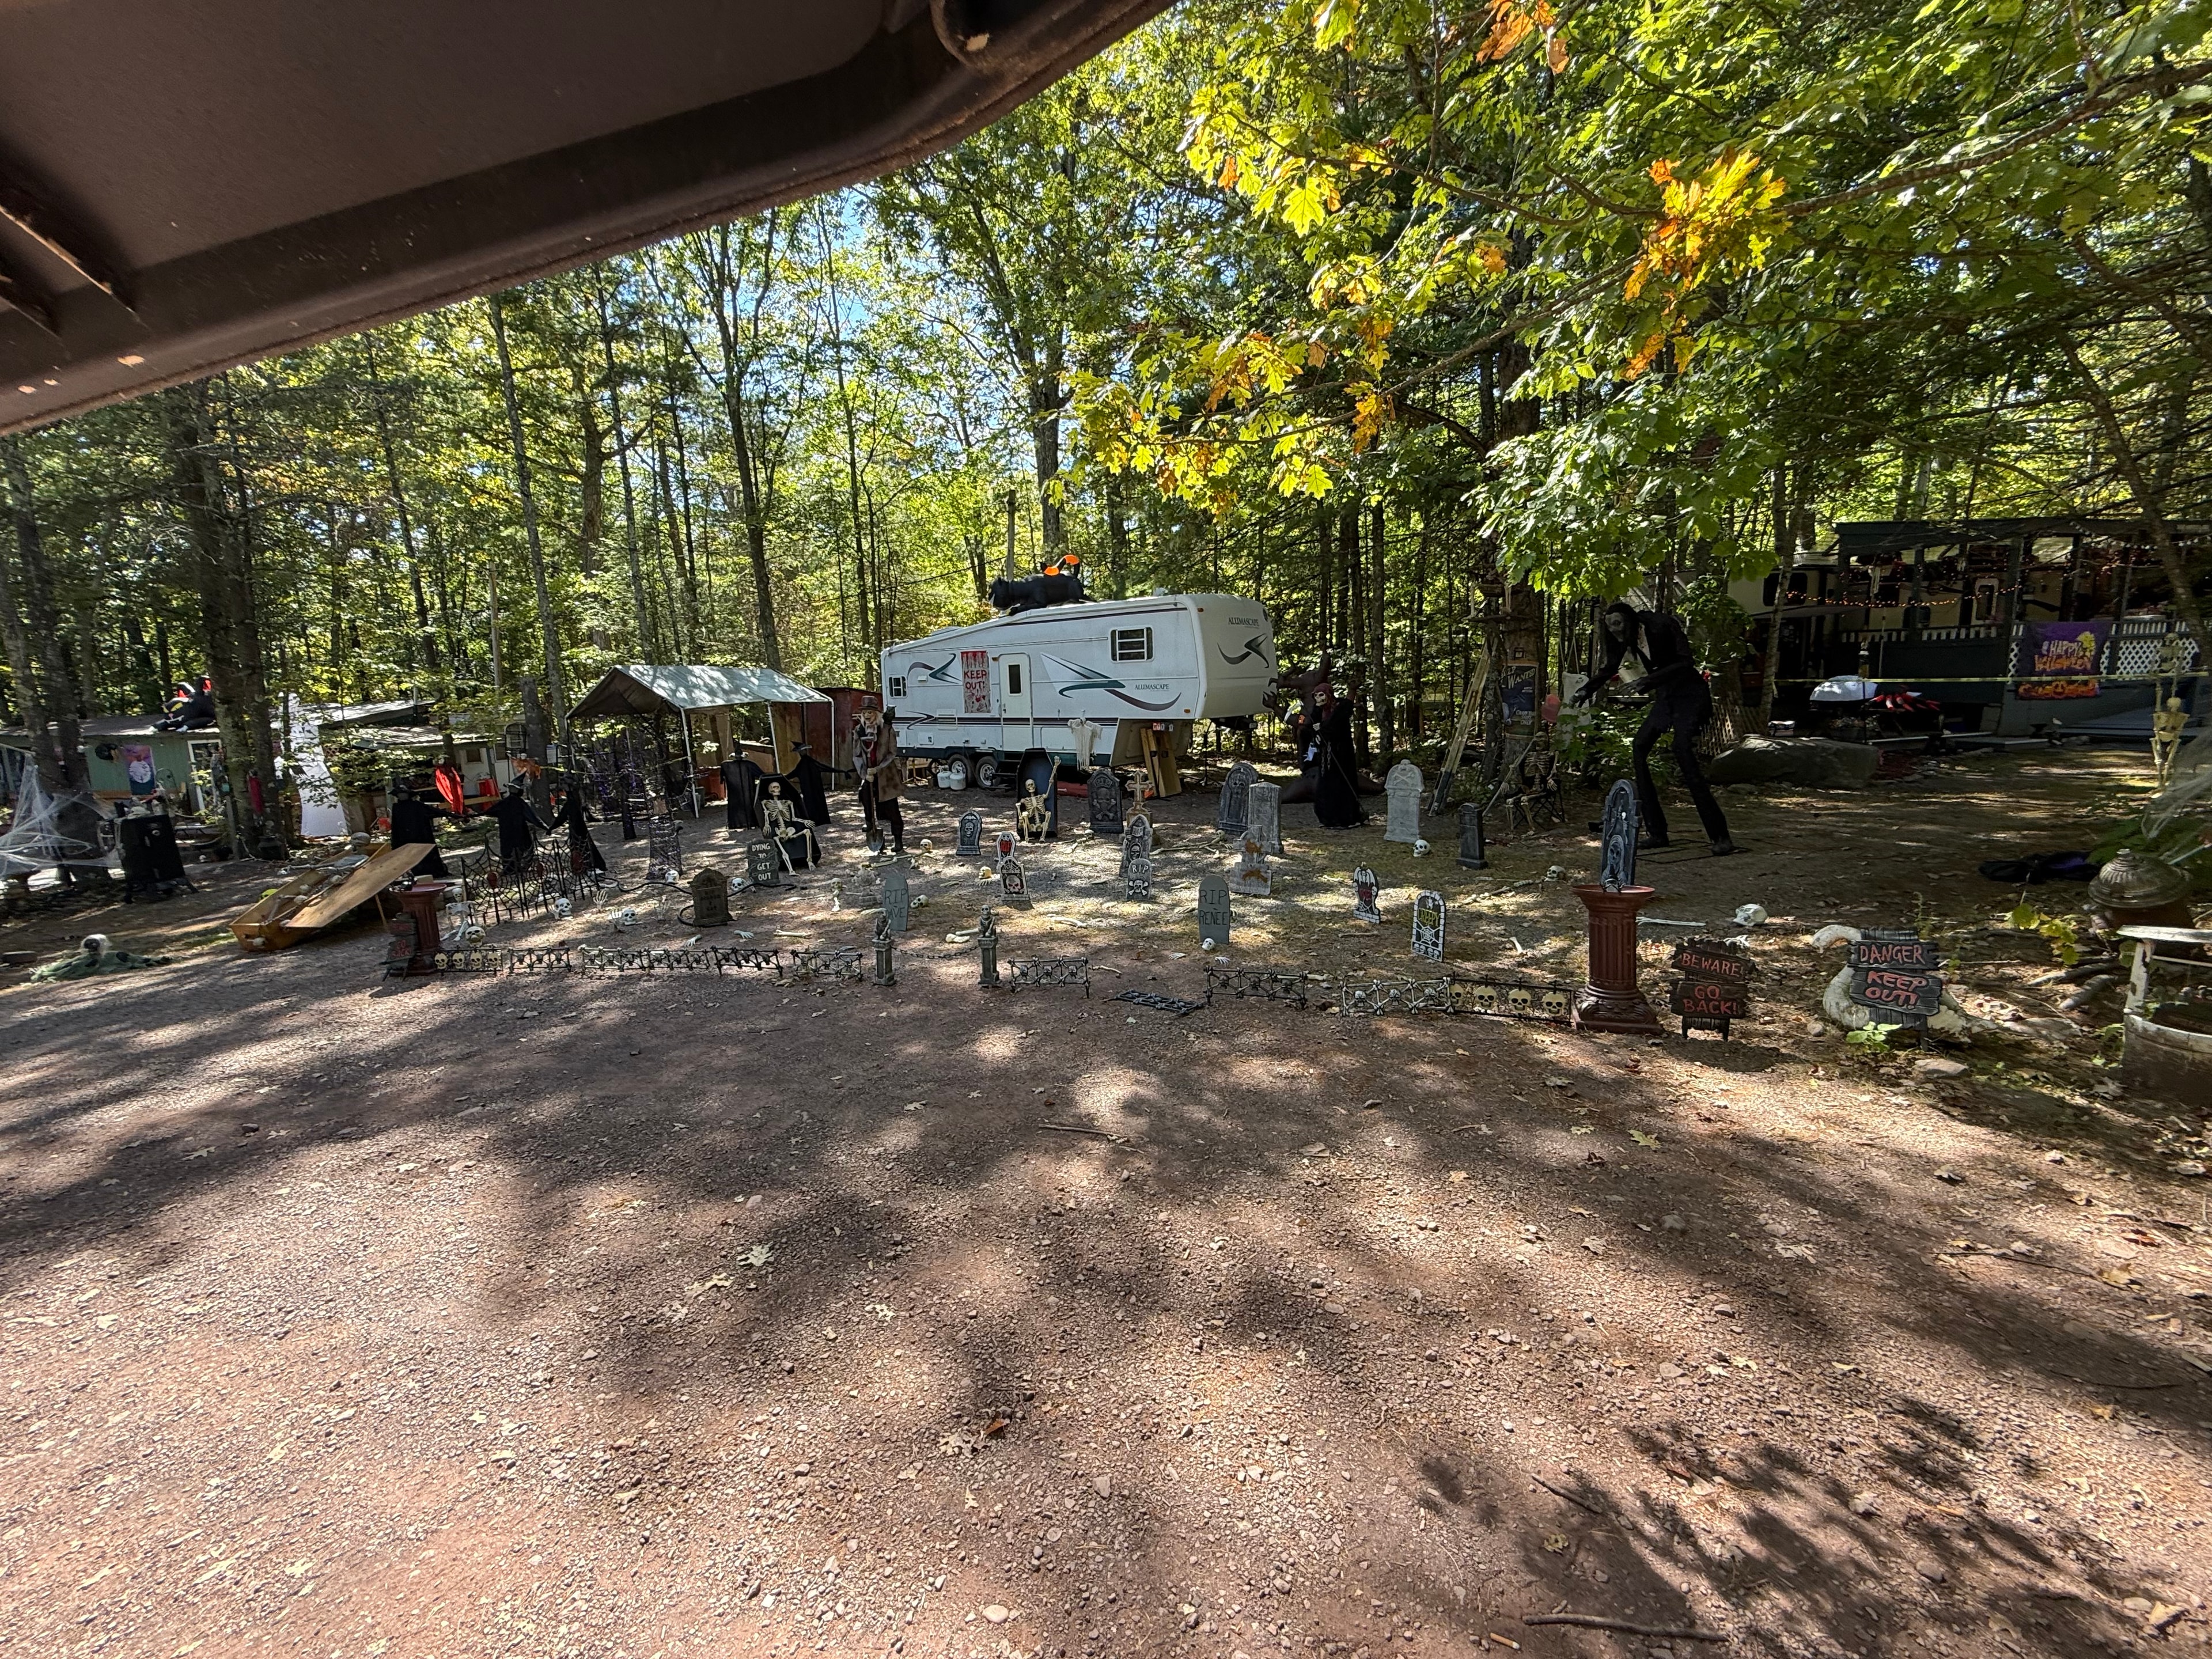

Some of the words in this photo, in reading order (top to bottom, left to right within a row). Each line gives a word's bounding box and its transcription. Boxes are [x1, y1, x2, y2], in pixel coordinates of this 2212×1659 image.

[2049, 640, 2082, 657] HAPPY
[964, 670, 987, 679] KEEP
[1508, 668, 1536, 689] WANTED
[965, 681, 985, 690] OUT!
[1096, 777, 1112, 786] RIP
[1133, 828, 1143, 836] RIP
[752, 843, 771, 852] DYING
[1001, 841, 1012, 852] RIP
[757, 862, 770, 870] GET
[1132, 864, 1149, 873] RIP
[757, 872, 771, 881] OUT
[884, 888, 907, 904] RIP
[1200, 889, 1227, 905] RIP
[1418, 908, 1441, 927] CREEPY
[1859, 944, 1926, 964] DANGER
[1867, 971, 1927, 991] KEEP
[1695, 986, 1720, 999] GO
[1865, 987, 1918, 1009] OUT!
[1683, 999, 1737, 1014] BACK!
